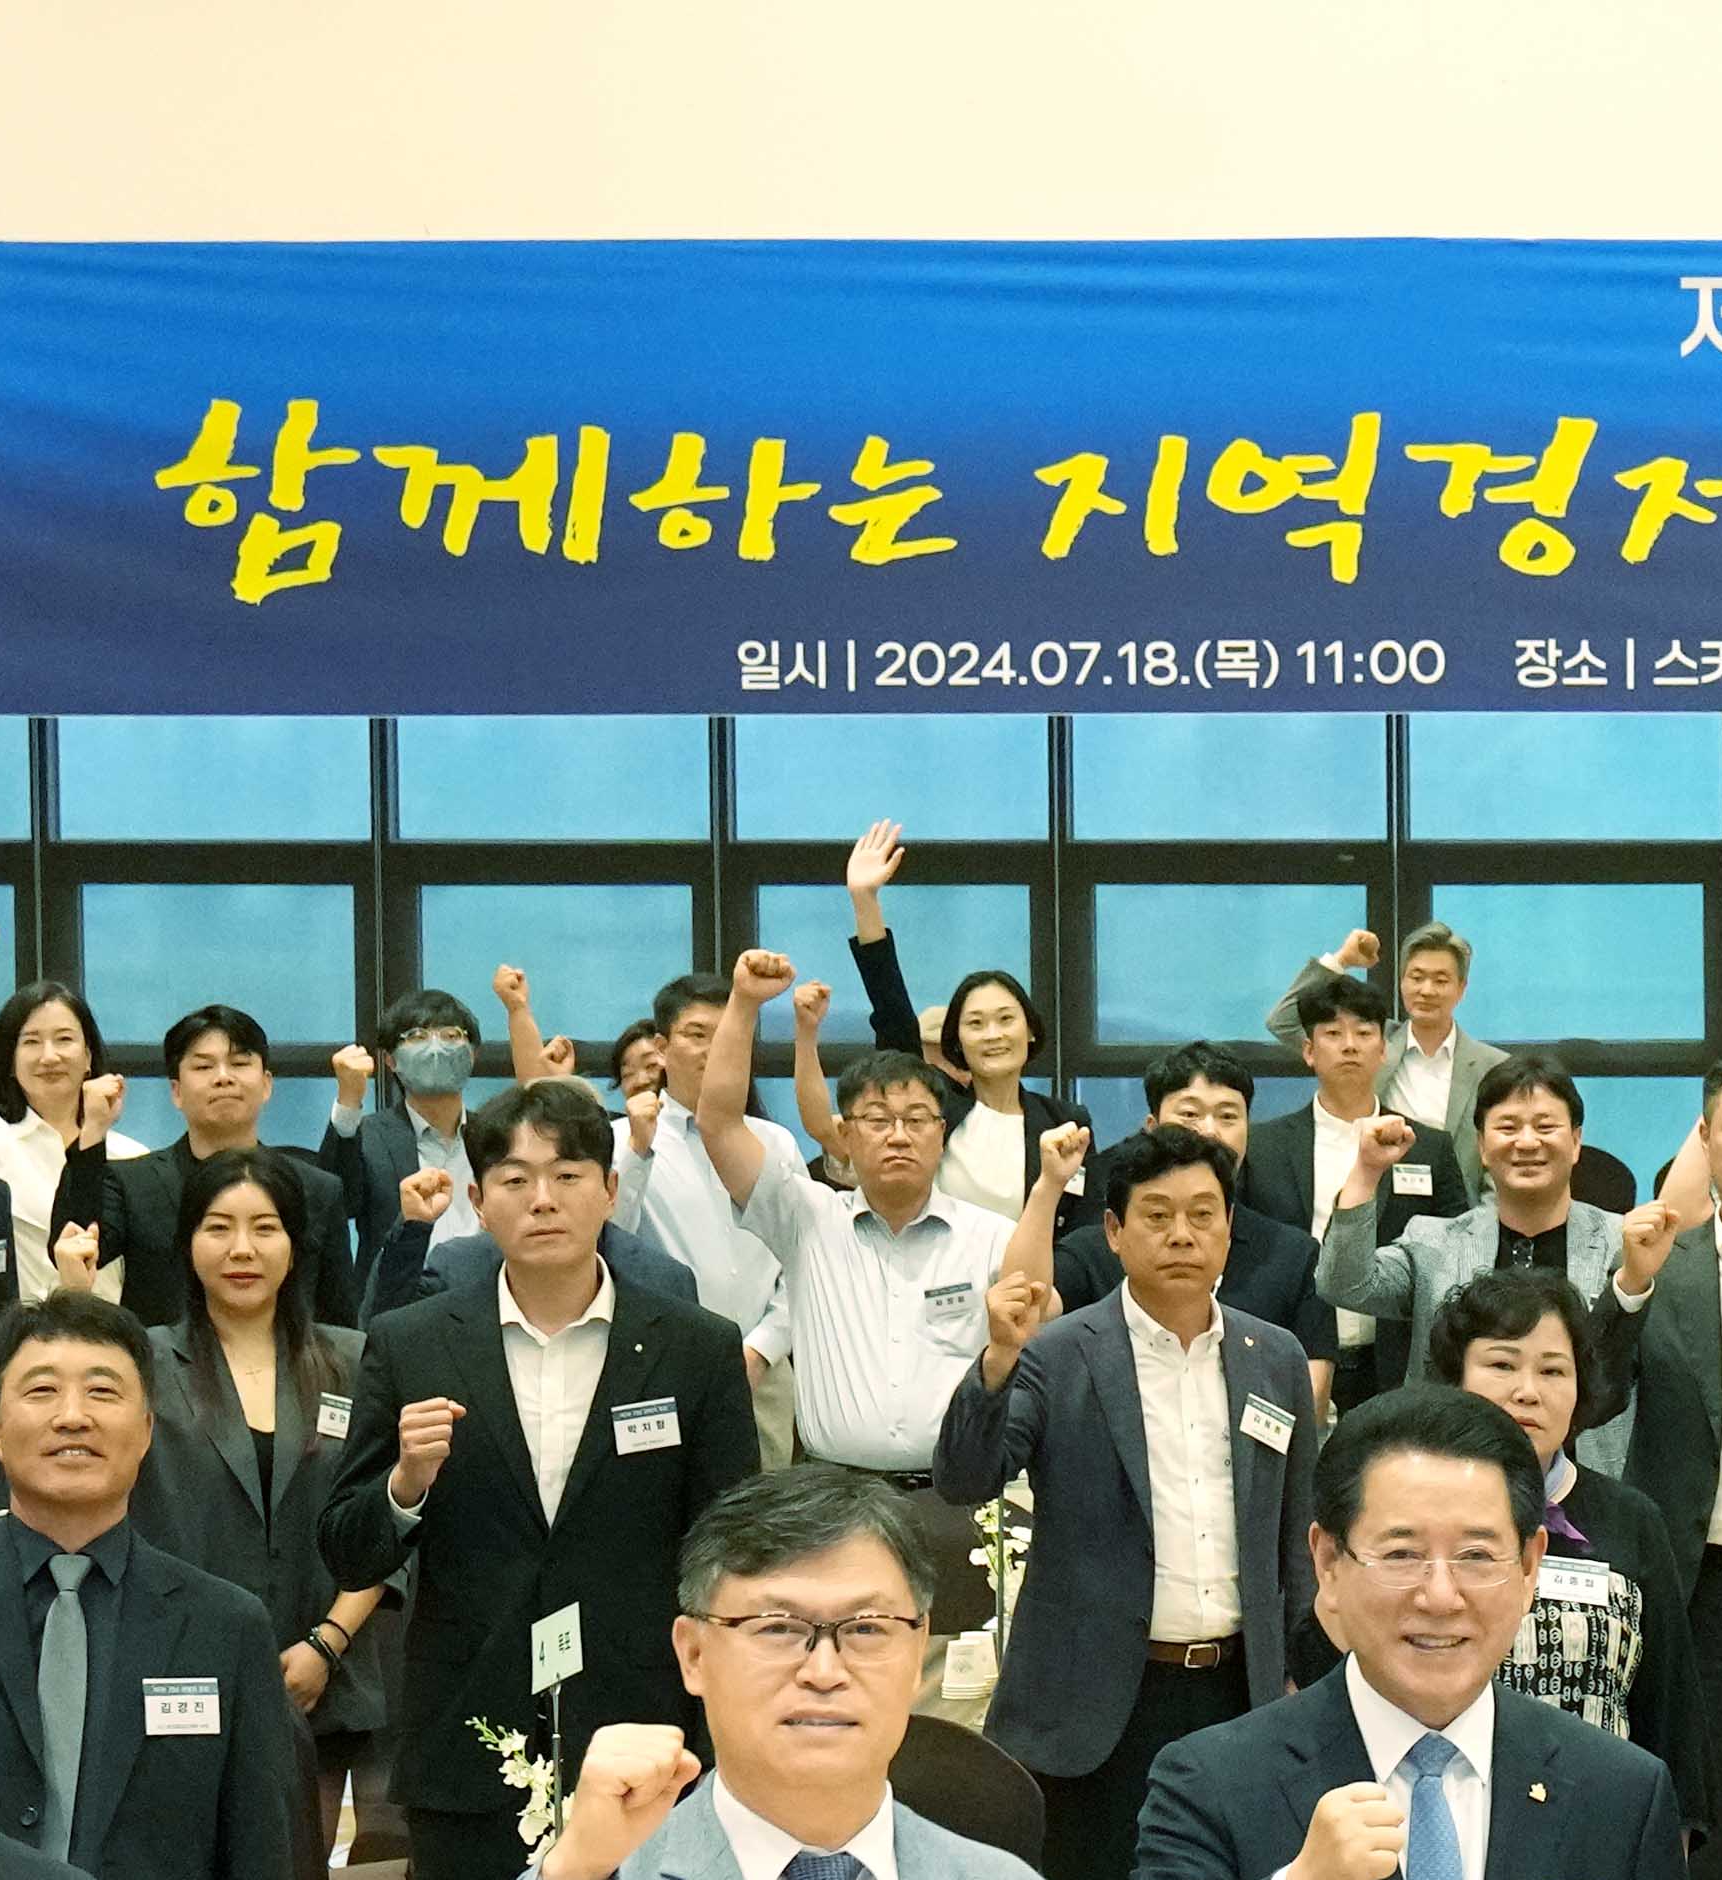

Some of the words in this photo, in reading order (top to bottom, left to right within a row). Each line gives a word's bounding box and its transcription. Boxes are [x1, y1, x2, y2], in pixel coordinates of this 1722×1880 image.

[155, 400, 957, 605] 함께하는
[738, 641, 828, 691] 일시
[876, 640, 1281, 690] 2024.07.18.(목)
[1297, 641, 1447, 686] 11:00
[1516, 639, 1609, 689] 장소
